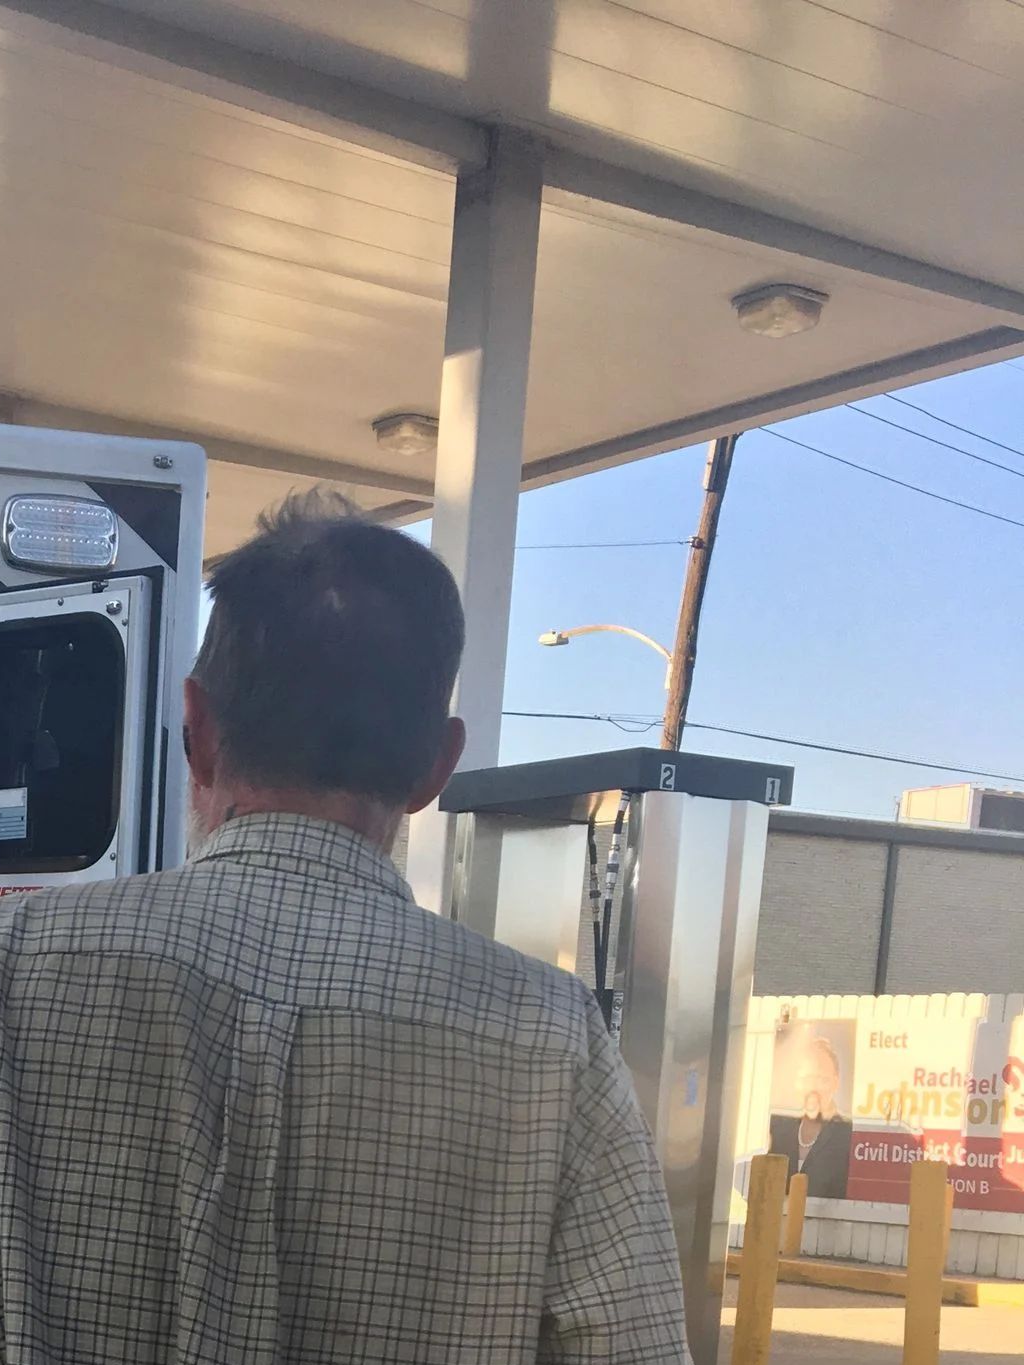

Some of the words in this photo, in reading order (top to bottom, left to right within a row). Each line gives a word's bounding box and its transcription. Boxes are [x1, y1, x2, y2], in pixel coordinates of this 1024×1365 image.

[662, 766, 673, 788] 2
[768, 780, 776, 802] 1
[869, 1031, 908, 1049] Elect
[913, 1067, 997, 1095] Rachael
[856, 1082, 1010, 1125] Johnson
[854, 1142, 888, 1162] Civil
[954, 1143, 1003, 1169] Court
[980, 1180, 990, 1194] B
